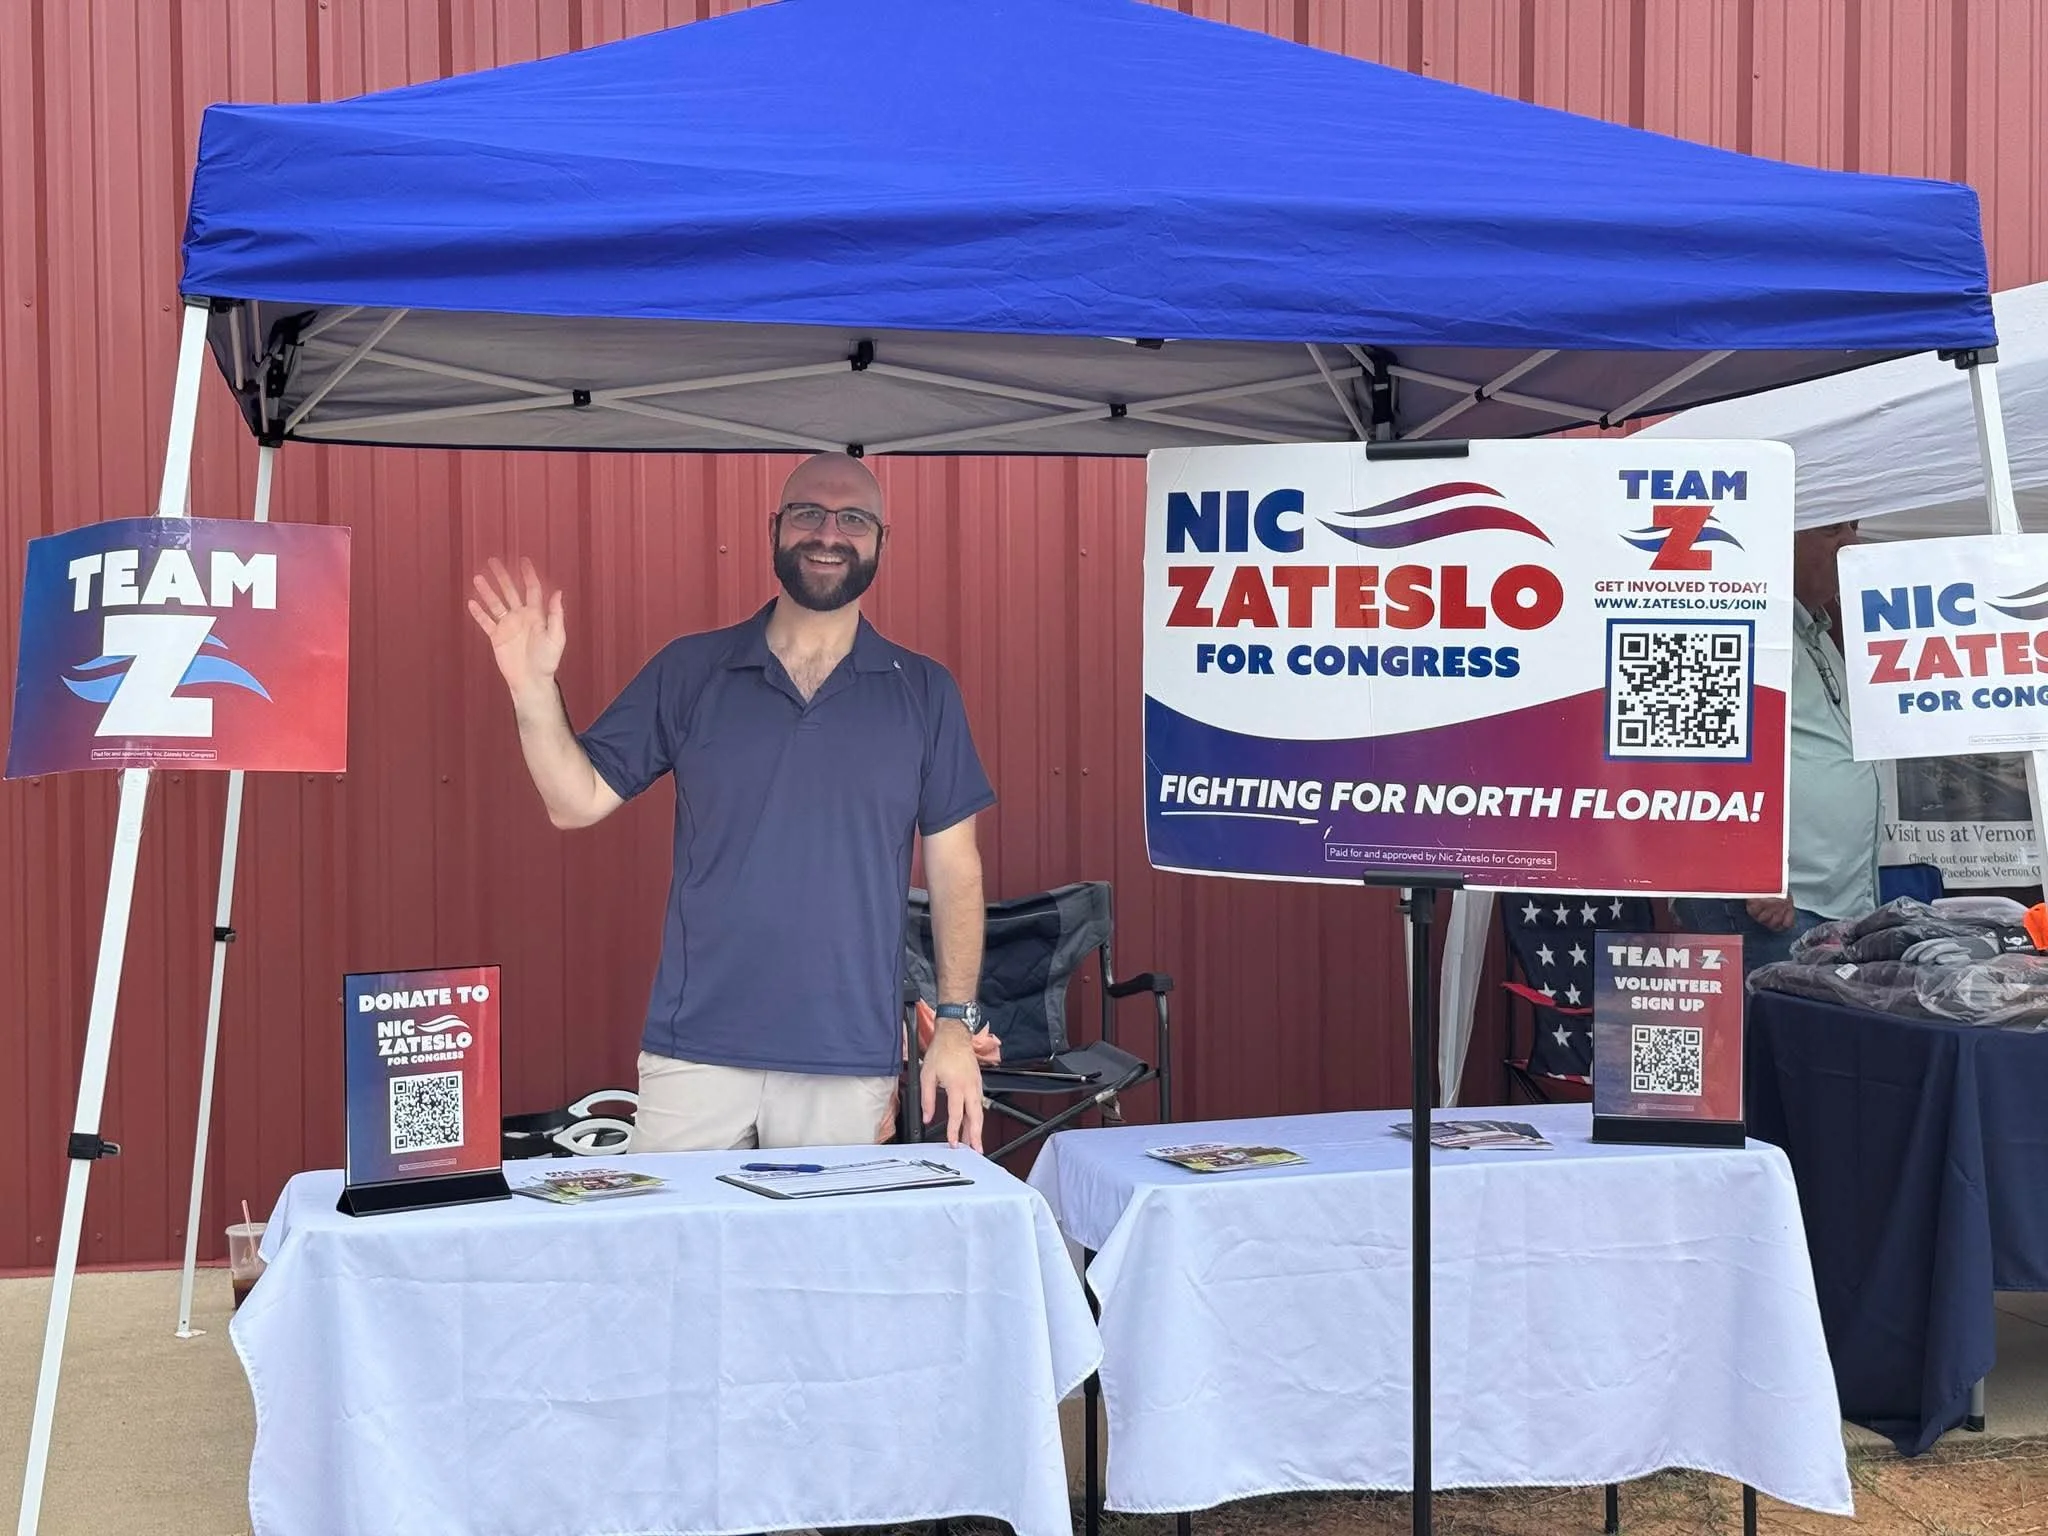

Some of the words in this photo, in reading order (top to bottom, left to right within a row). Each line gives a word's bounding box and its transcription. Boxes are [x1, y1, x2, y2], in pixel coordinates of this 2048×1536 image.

[1618, 470, 1748, 501] TEAM
[1166, 488, 1305, 553] NIC
[1649, 505, 1715, 571] Z
[68, 549, 277, 612] TEAM
[1594, 580, 1624, 593] GET
[1627, 581, 1705, 593] INVOLVED
[1709, 582, 1768, 594] TODAY!
[1166, 564, 1564, 631] ZATESLO
[1594, 598, 1768, 610] WWW.ZATESLO.US/JOIN
[1861, 582, 1977, 633] NIC
[1197, 643, 1274, 675] FOR
[1287, 644, 1521, 679] CONGRESS
[94, 614, 217, 738] Z
[1898, 689, 1964, 714] FOR
[1159, 775, 1322, 811] FIGHTING
[1330, 782, 1406, 813] FOR
[1414, 784, 1562, 818] NORTH
[1570, 788, 1765, 823] FLORIDA!
[1884, 824, 1921, 843] Visit
[1926, 828, 1945, 843] us
[1950, 826, 1969, 843] at
[1973, 825, 2036, 842] Vernon
[1329, 848, 1348, 857] Paid
[1350, 849, 1362, 858] for
[1364, 850, 1380, 859] and
[1382, 850, 1424, 861] approved
[1426, 852, 1437, 862] by
[1439, 852, 1453, 862] Nic
[1455, 853, 1490, 863] Zateslo
[1492, 854, 1505, 864] for
[1507, 855, 1553, 867] Congress
[1939, 854, 1958, 864] out
[1959, 855, 1978, 864] our
[1980, 852, 2018, 863] website
[1941, 866, 1990, 879] Facebook
[1992, 866, 2029, 878] Vernon
[1607, 946, 1690, 969] TEAM
[1701, 949, 1721, 970] Z
[1614, 976, 1723, 994] VOLUNTEER
[358, 987, 452, 1013] DONATE
[457, 984, 490, 1004] TO
[1631, 996, 1674, 1011] SIGN
[1679, 998, 1705, 1012] UP
[377, 1019, 415, 1038] NIC
[378, 1031, 473, 1056] ZATESLO
[387, 1055, 409, 1066] FOR
[410, 1050, 464, 1065] CONGRESS
